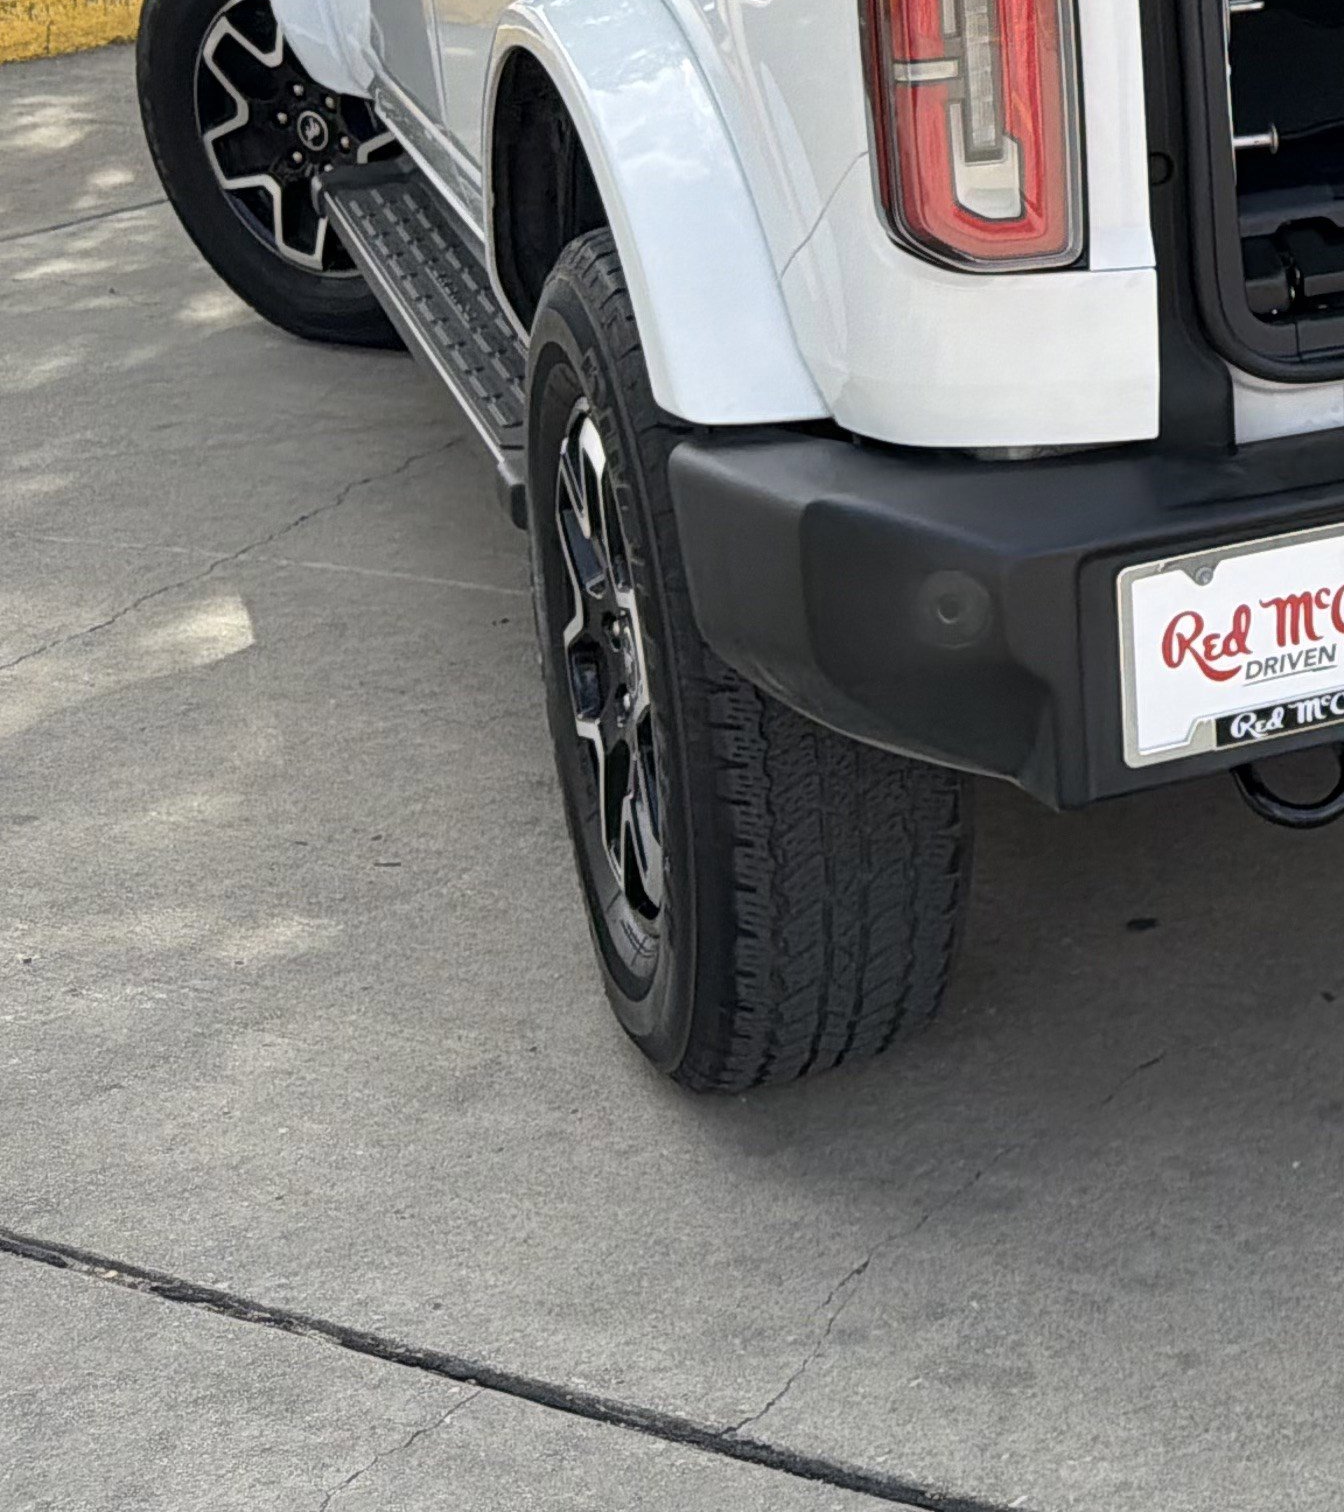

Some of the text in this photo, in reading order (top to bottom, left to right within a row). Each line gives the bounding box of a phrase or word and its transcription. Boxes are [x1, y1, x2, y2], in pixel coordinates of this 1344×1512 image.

[1162, 603, 1253, 682] Red
[1245, 643, 1337, 680] DRIVEN
[1230, 706, 1285, 738] Red
